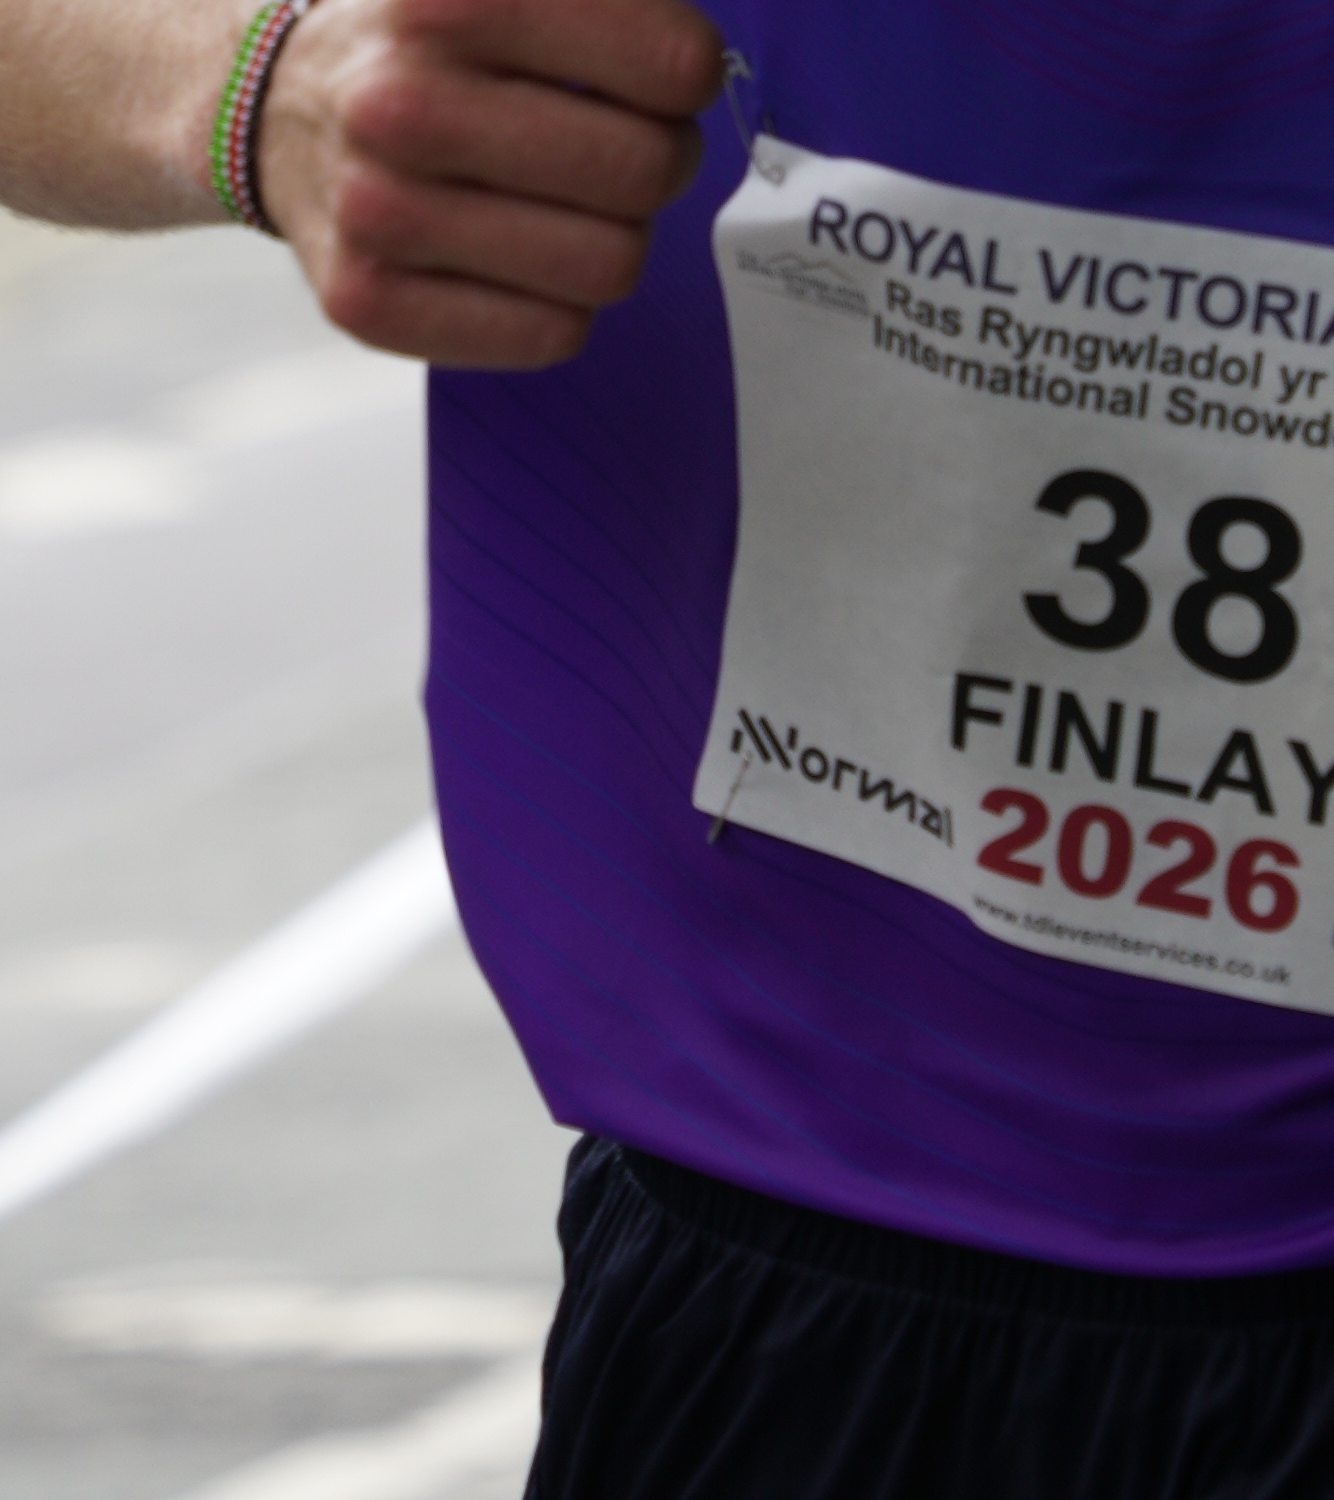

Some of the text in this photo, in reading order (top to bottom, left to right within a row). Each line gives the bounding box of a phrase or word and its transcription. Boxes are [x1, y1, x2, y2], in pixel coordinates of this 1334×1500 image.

[809, 196, 1018, 296] ROYAL
[872, 312, 1150, 420] International
[885, 279, 963, 339] Ras
[979, 305, 1263, 389] Ryngwladol
[1279, 364, 1328, 405] yr
[1022, 467, 1303, 684] 38
[730, 707, 955, 848] Normal
[976, 786, 1303, 934] 2026
